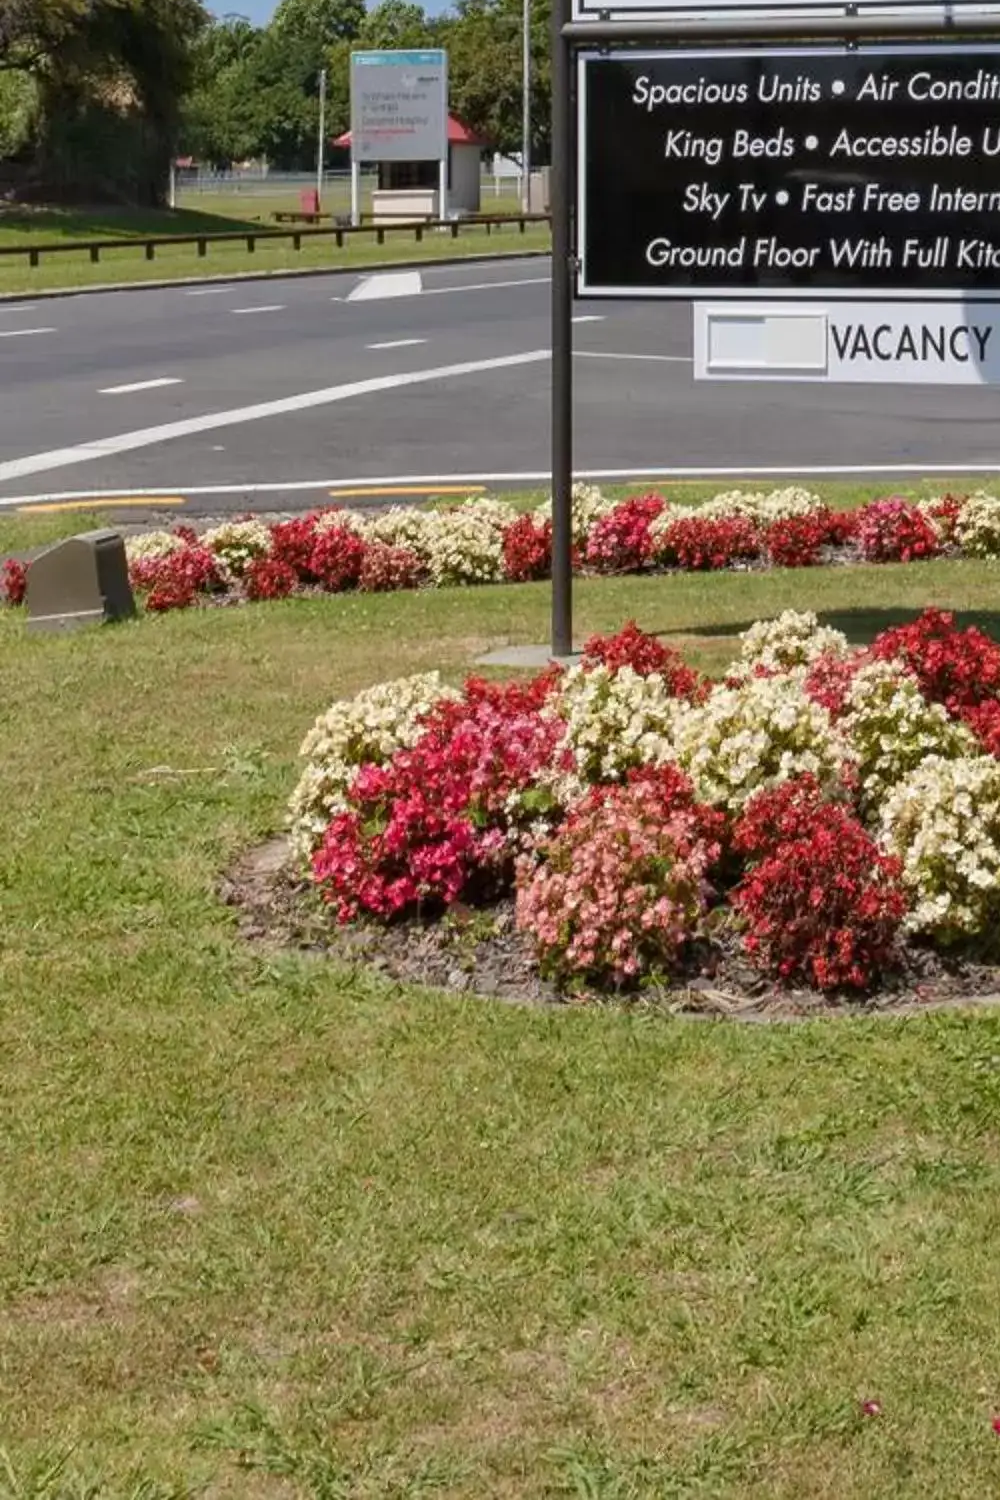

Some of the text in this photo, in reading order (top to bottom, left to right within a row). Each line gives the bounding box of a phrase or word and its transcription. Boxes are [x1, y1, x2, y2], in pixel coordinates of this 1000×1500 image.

[632, 75, 748, 112] Spacious
[758, 74, 821, 103] Units
[856, 73, 900, 101] Air
[665, 130, 723, 165] King
[732, 127, 794, 157] Beds
[829, 127, 973, 157] Accessible
[682, 182, 730, 220] Sky
[739, 183, 767, 211] Tv
[801, 183, 856, 212] Fast
[863, 183, 921, 212] Free
[645, 236, 746, 267] Ground
[753, 236, 821, 267] Floor
[829, 236, 892, 267] With
[902, 237, 949, 268] Full
[831, 324, 993, 363] VACANCY
